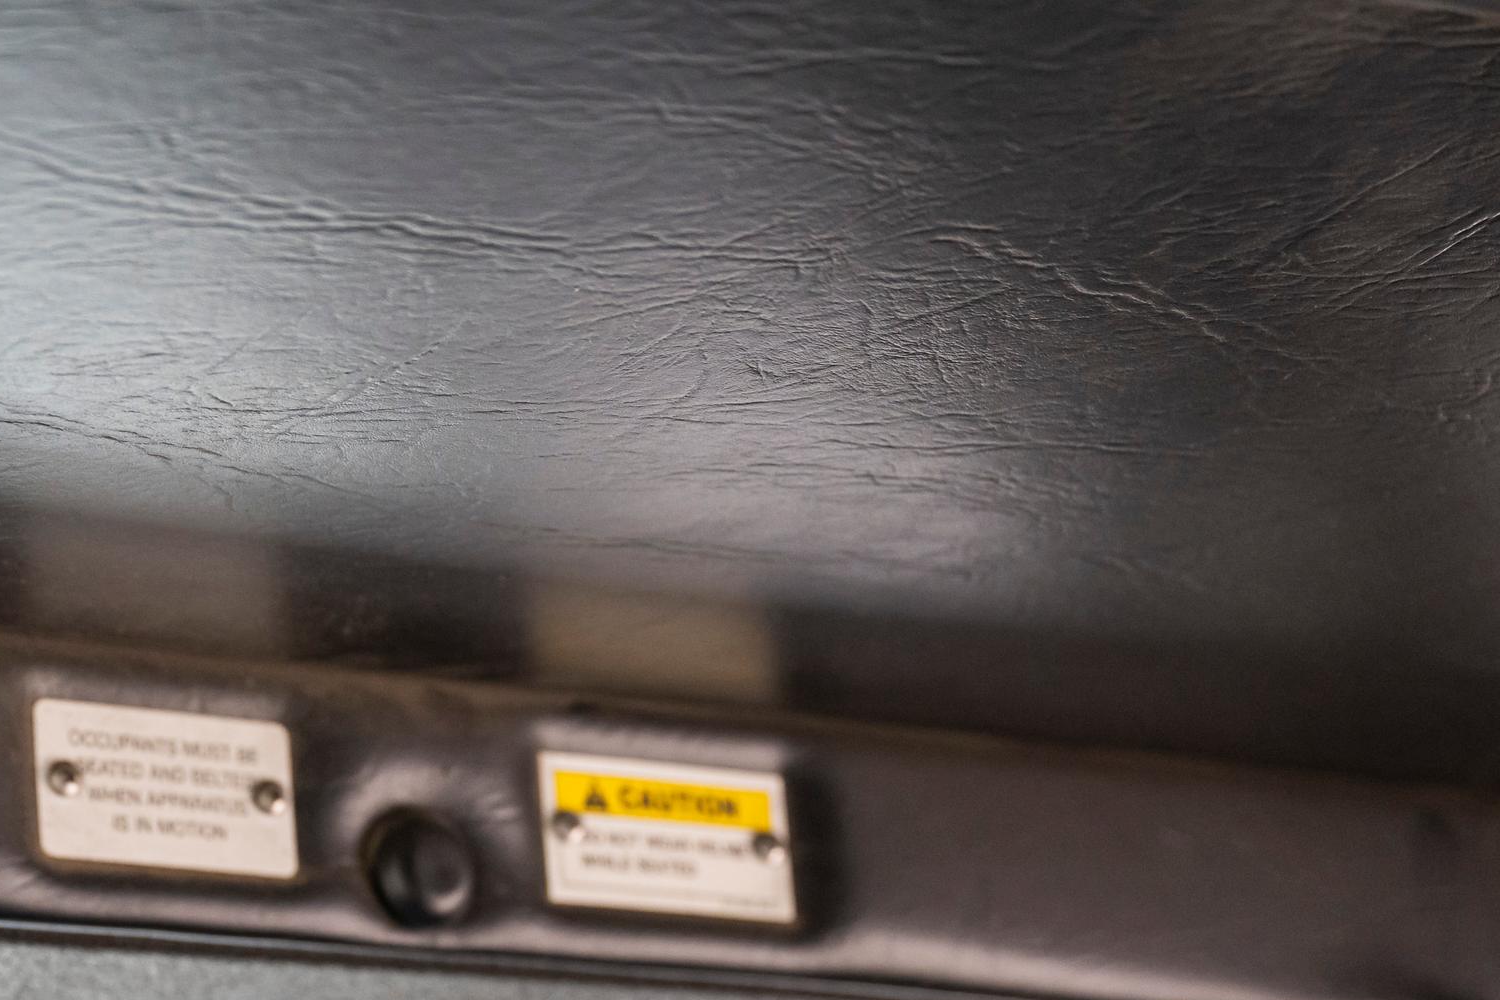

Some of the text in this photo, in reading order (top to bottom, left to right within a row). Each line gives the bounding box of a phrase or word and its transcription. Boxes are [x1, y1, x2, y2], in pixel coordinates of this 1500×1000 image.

[68, 728, 258, 765] OCCUPANTS MUST BE
[150, 765, 185, 785] AND
[89, 786, 248, 818] WHEN APPARATUS
[618, 784, 739, 818] CAUTION
[113, 814, 229, 842] IS IN MOTION
